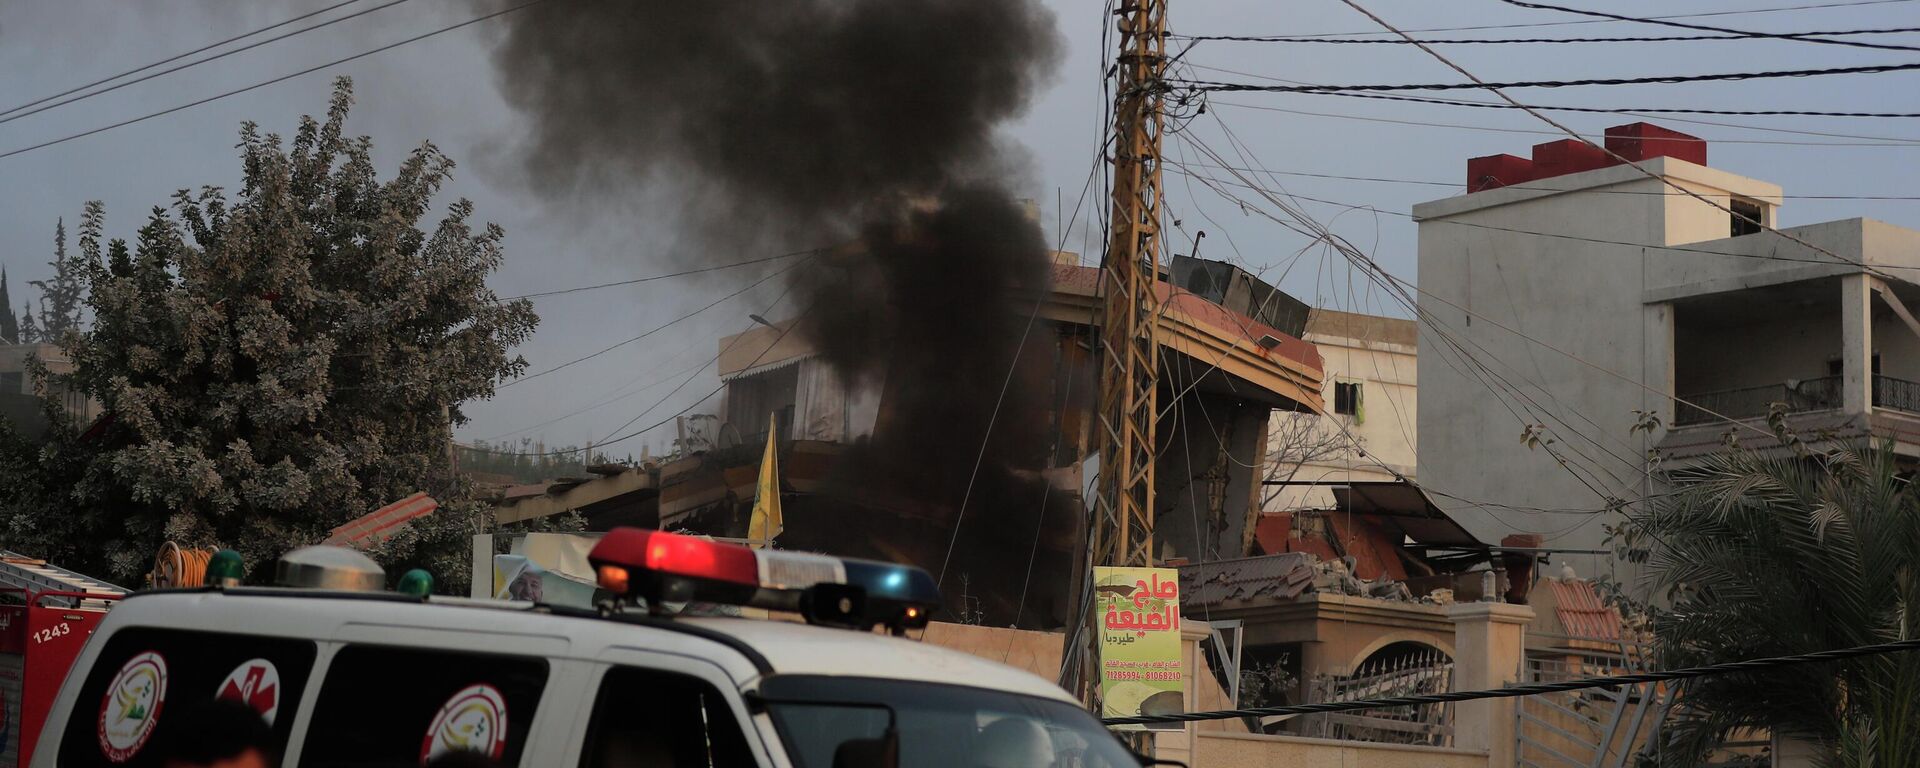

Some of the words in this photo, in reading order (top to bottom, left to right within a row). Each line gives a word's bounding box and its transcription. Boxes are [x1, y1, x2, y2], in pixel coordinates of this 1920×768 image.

[1132, 573, 1177, 608] صاج
[1105, 604, 1179, 638] الضيعة
[33, 622, 70, 644] 1243
[1105, 632, 1135, 646] طيردبا
[1105, 670, 1140, 680] 71285994
[1145, 671, 1181, 680] 81068210
